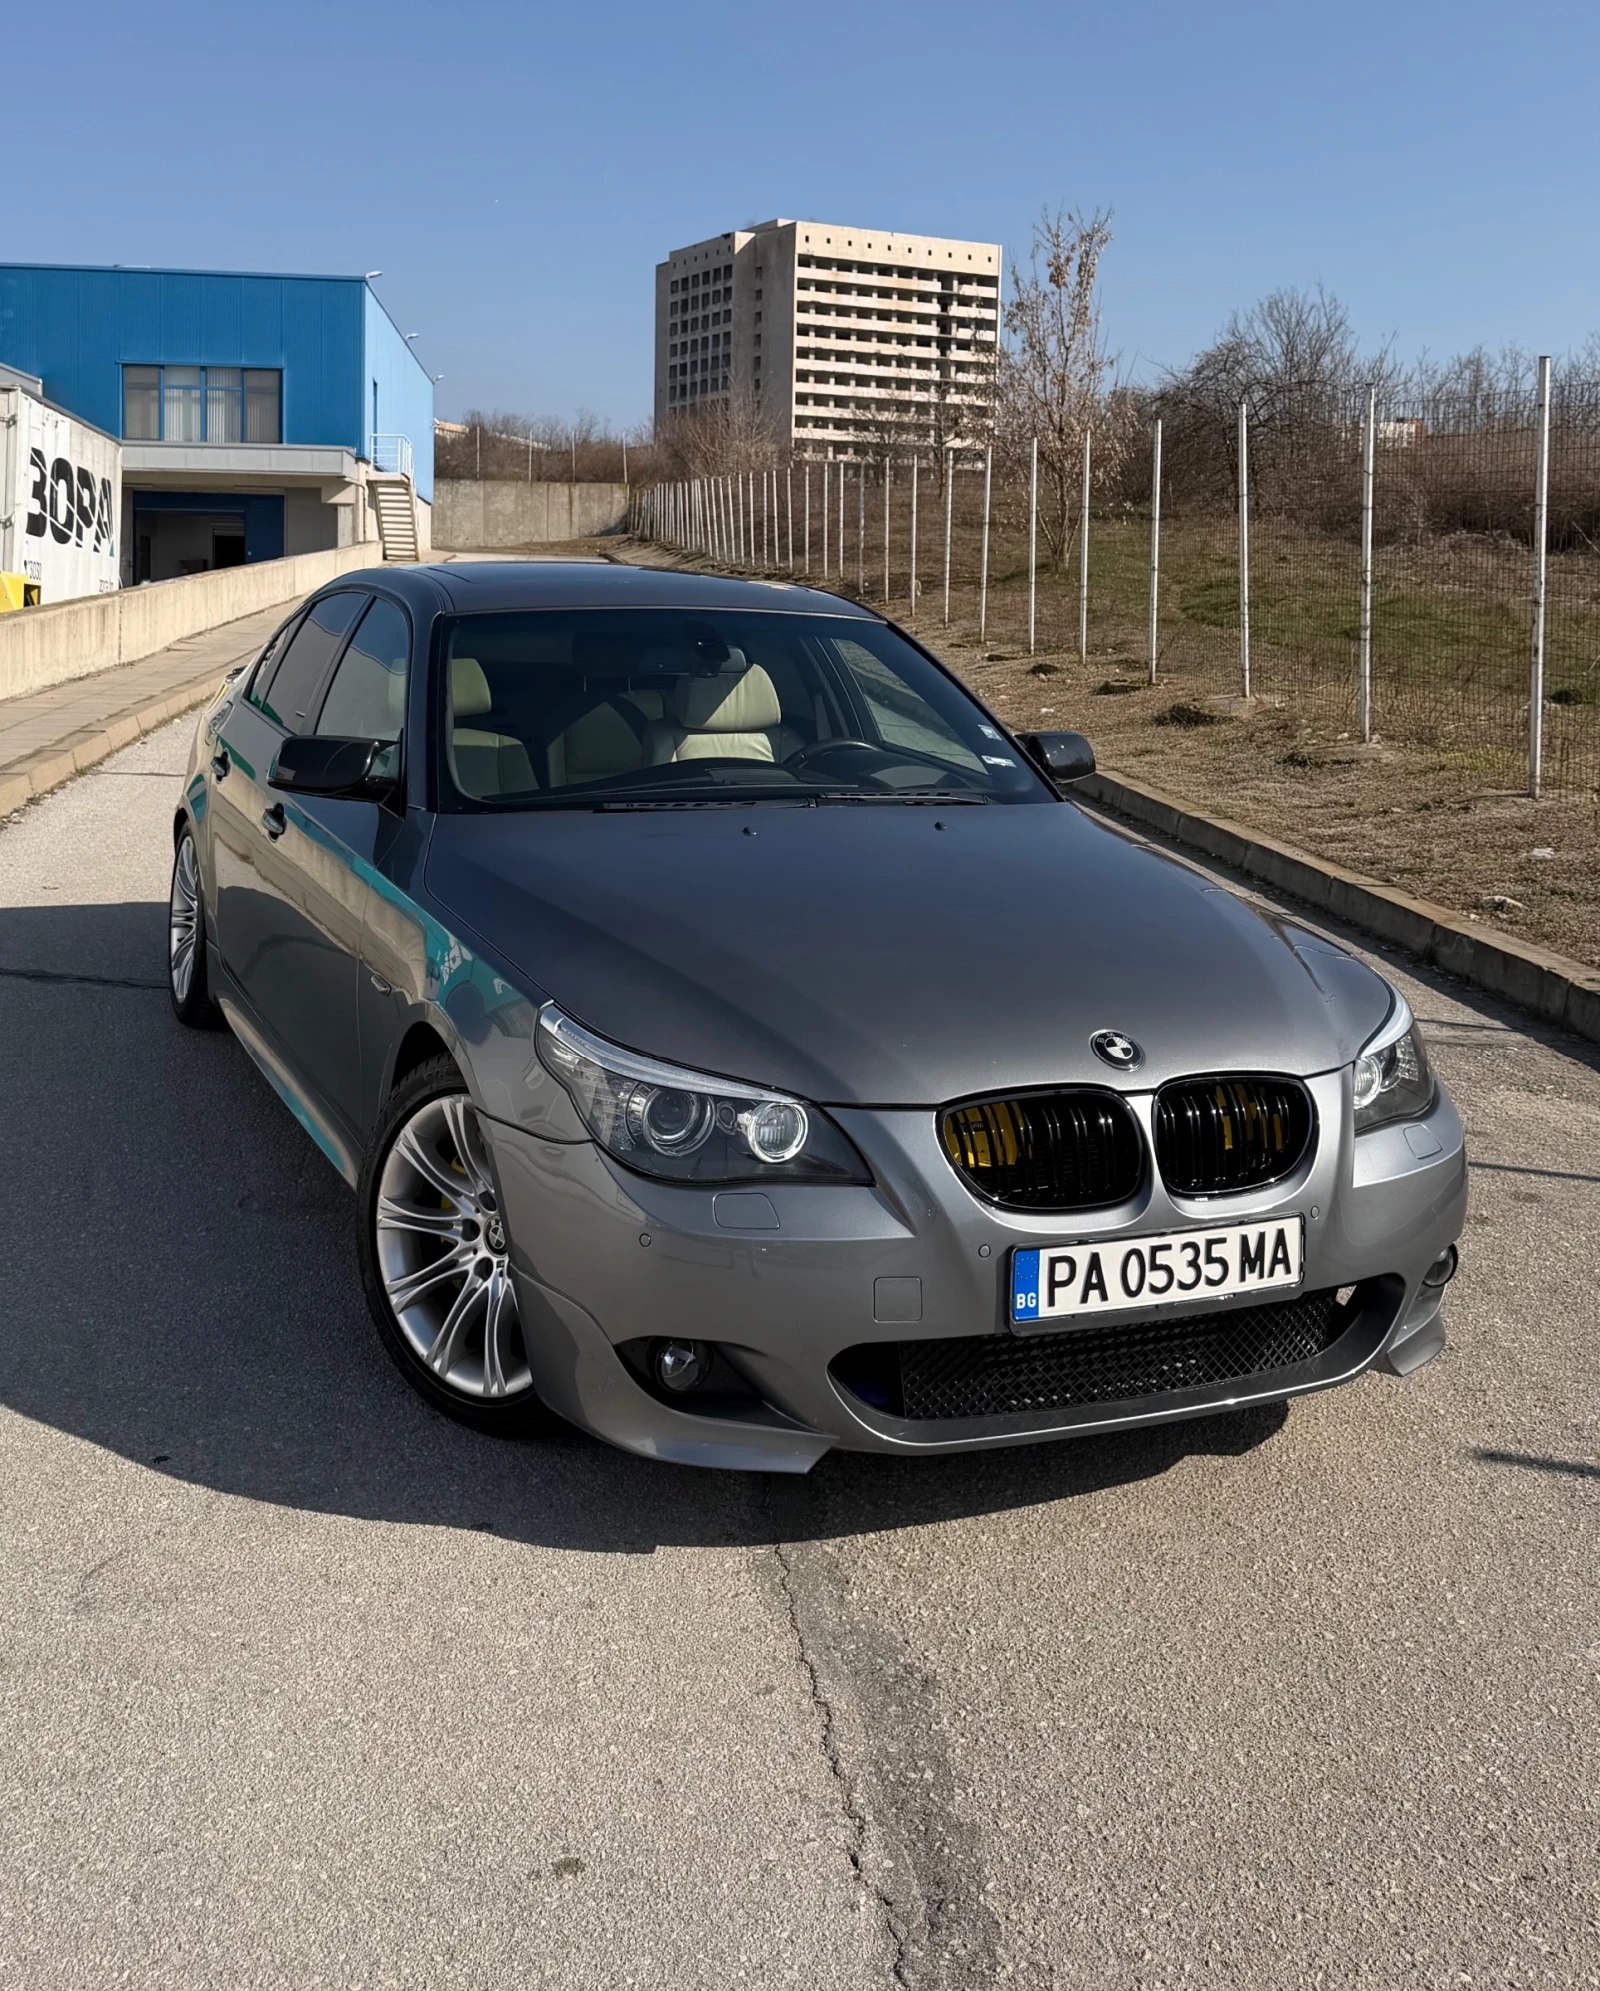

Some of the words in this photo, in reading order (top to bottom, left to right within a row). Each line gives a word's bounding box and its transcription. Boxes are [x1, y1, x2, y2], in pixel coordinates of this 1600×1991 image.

[1047, 1252, 1108, 1307] PA
[1120, 1237, 1229, 1298] 0535
[1238, 1228, 1292, 1283] MA
[1016, 1293, 1037, 1309] BG
